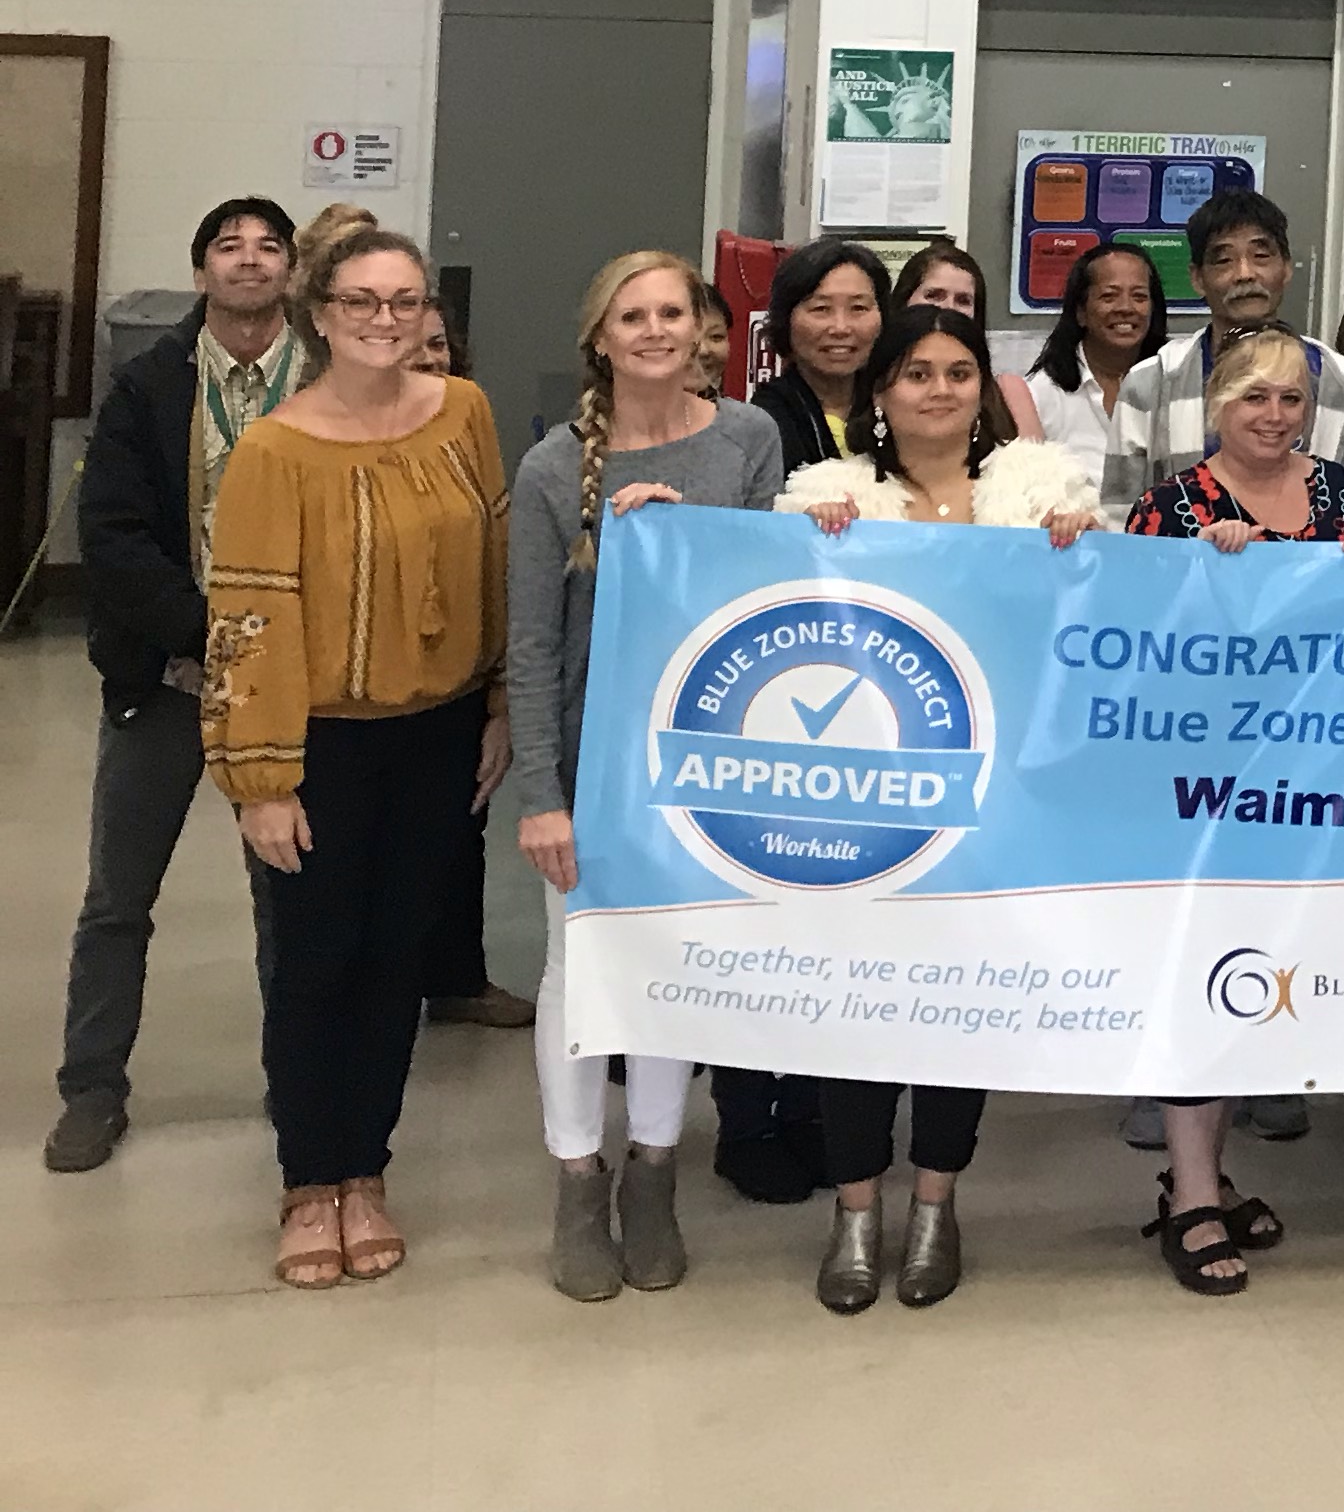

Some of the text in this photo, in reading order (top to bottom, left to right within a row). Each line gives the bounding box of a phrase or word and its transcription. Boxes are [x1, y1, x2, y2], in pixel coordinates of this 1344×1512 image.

[835, 70, 867, 80] AND
[1072, 135, 1216, 154] 1 TERRIFIC TRAY
[697, 620, 952, 730] BLUE ZONES PROJECT
[1088, 697, 1209, 743] Blue
[760, 832, 860, 861] Worksite
[681, 940, 1120, 1002] Together, we can help our
[647, 980, 1144, 1034] community live longer, better.
